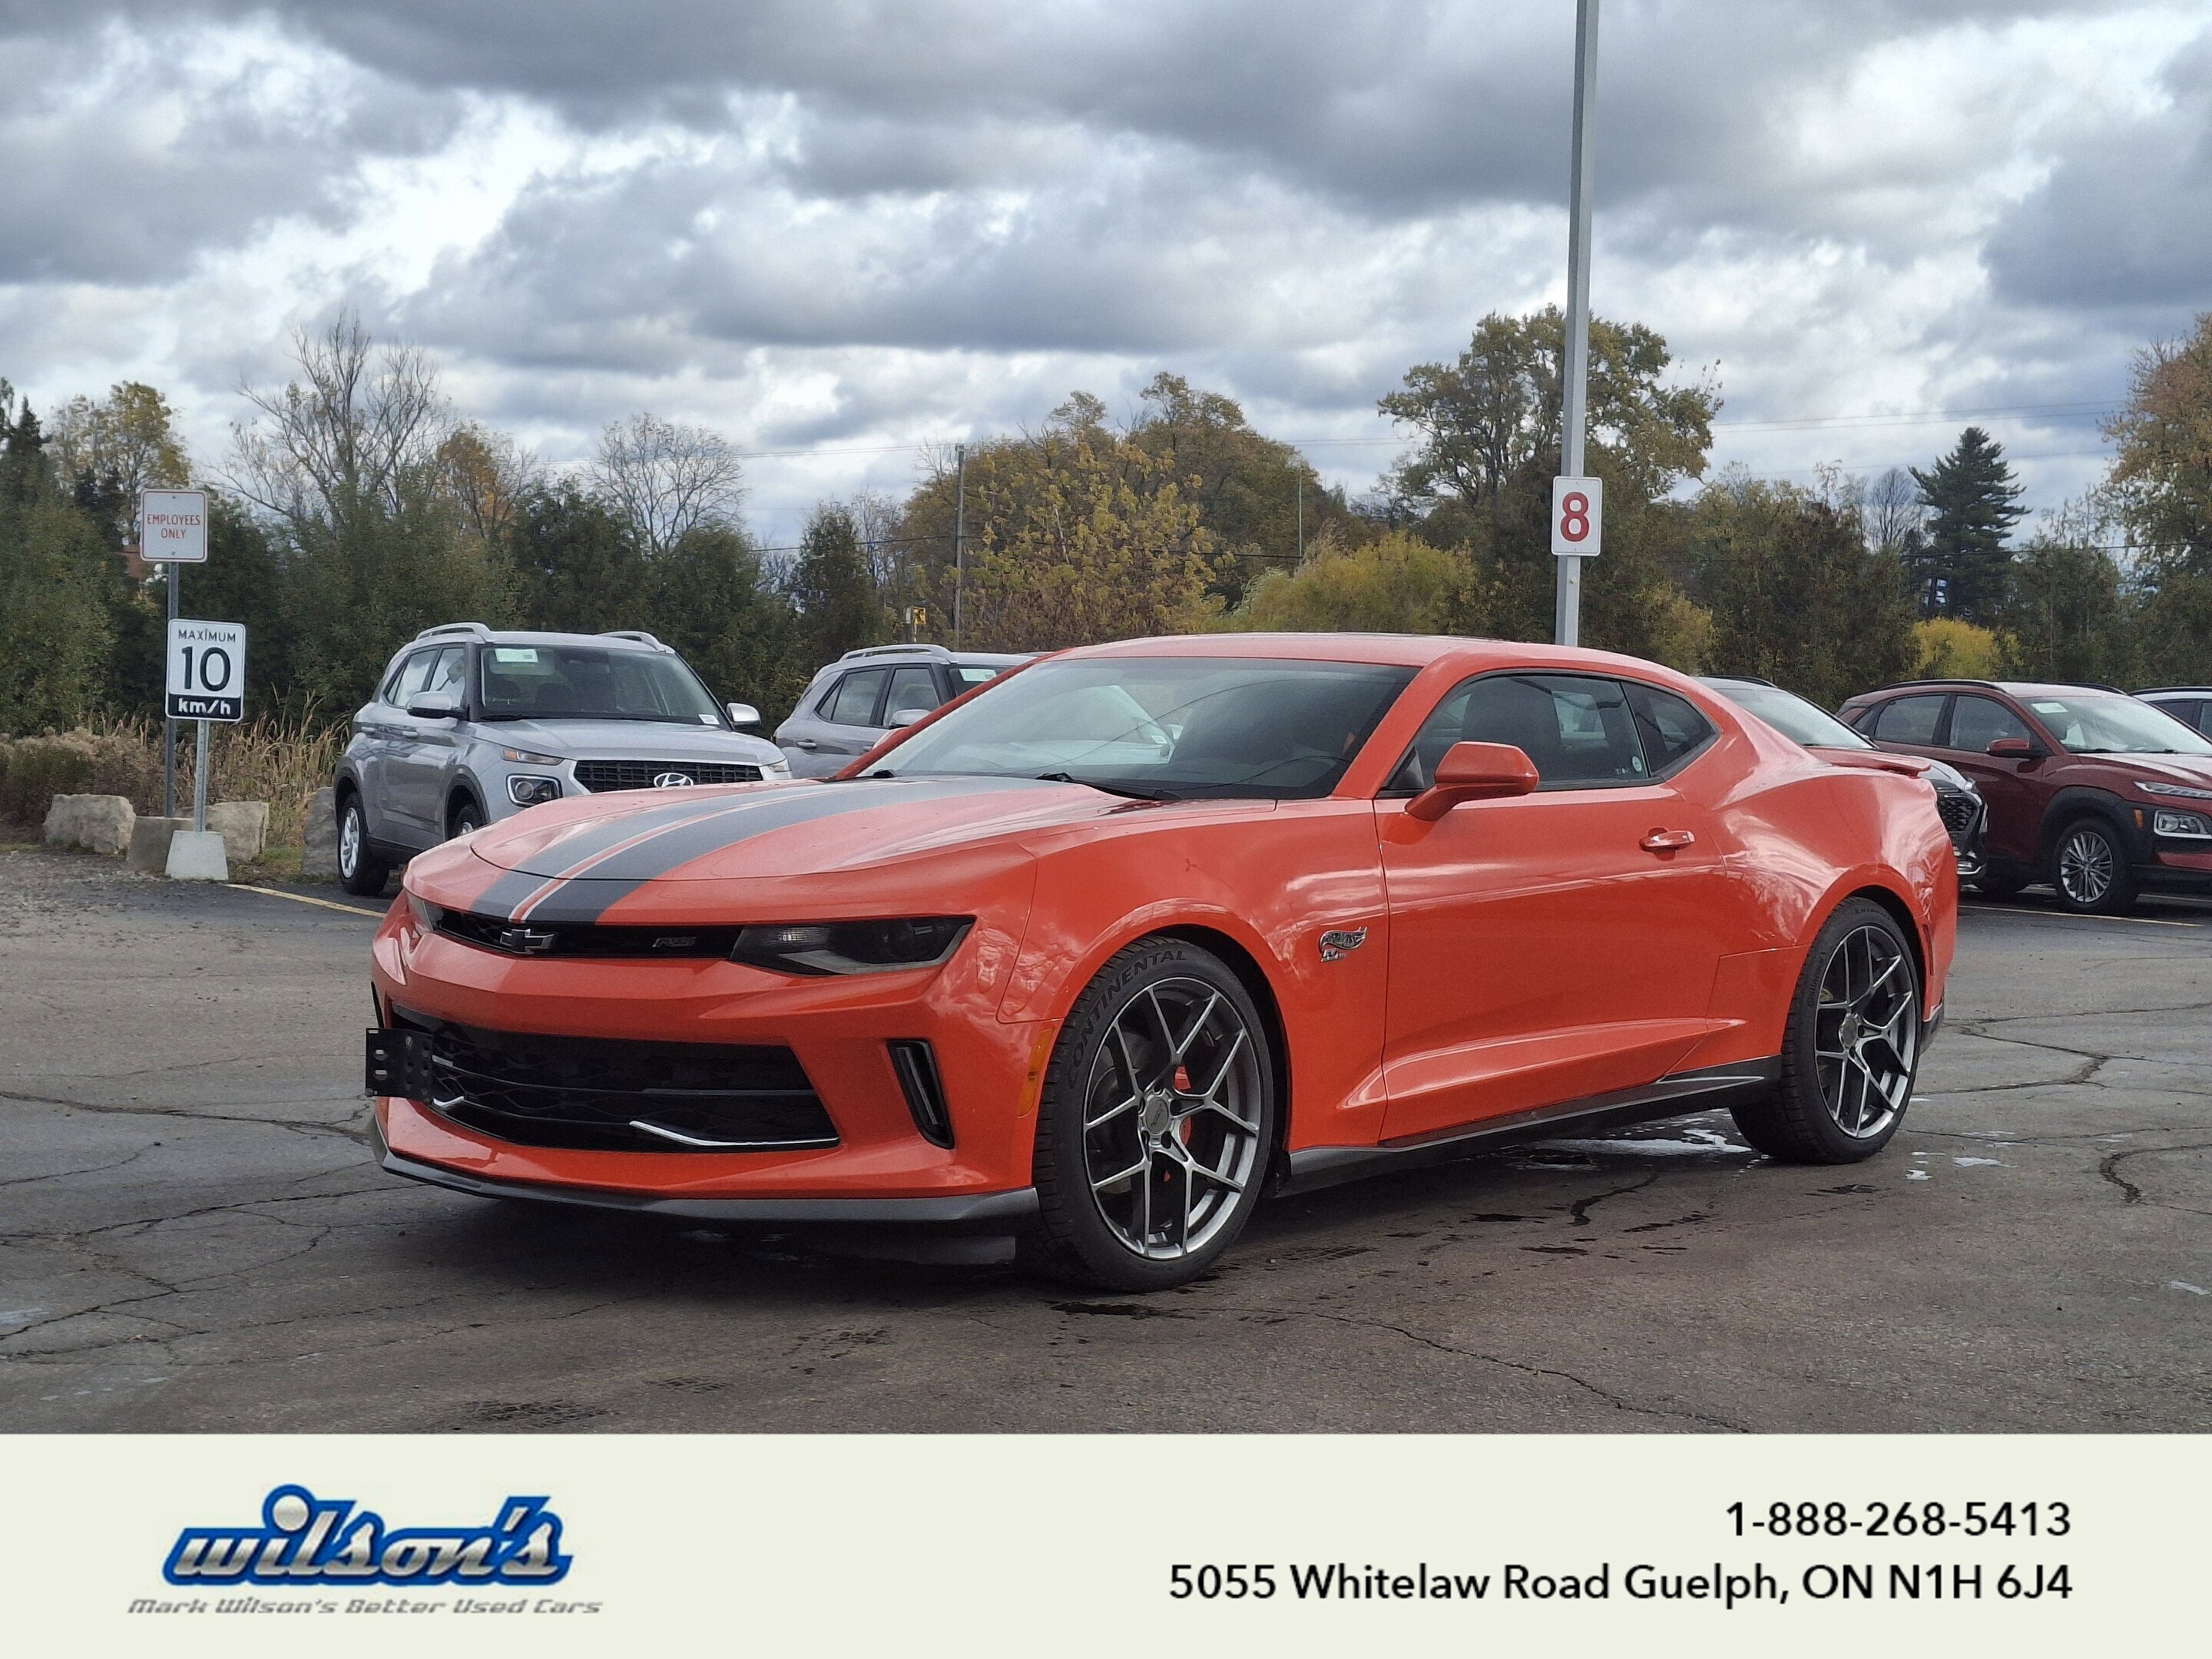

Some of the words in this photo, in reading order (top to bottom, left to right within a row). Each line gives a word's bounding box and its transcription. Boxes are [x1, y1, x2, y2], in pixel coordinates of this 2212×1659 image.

[147, 514, 200, 526] EMPLOYEES
[1560, 491, 1590, 542] 8
[161, 528, 187, 539] ONLY
[177, 628, 236, 643] MAXIMUM
[180, 645, 231, 692] 10
[177, 697, 231, 715] km/h
[1068, 949, 1187, 1091] CONTINENTAL
